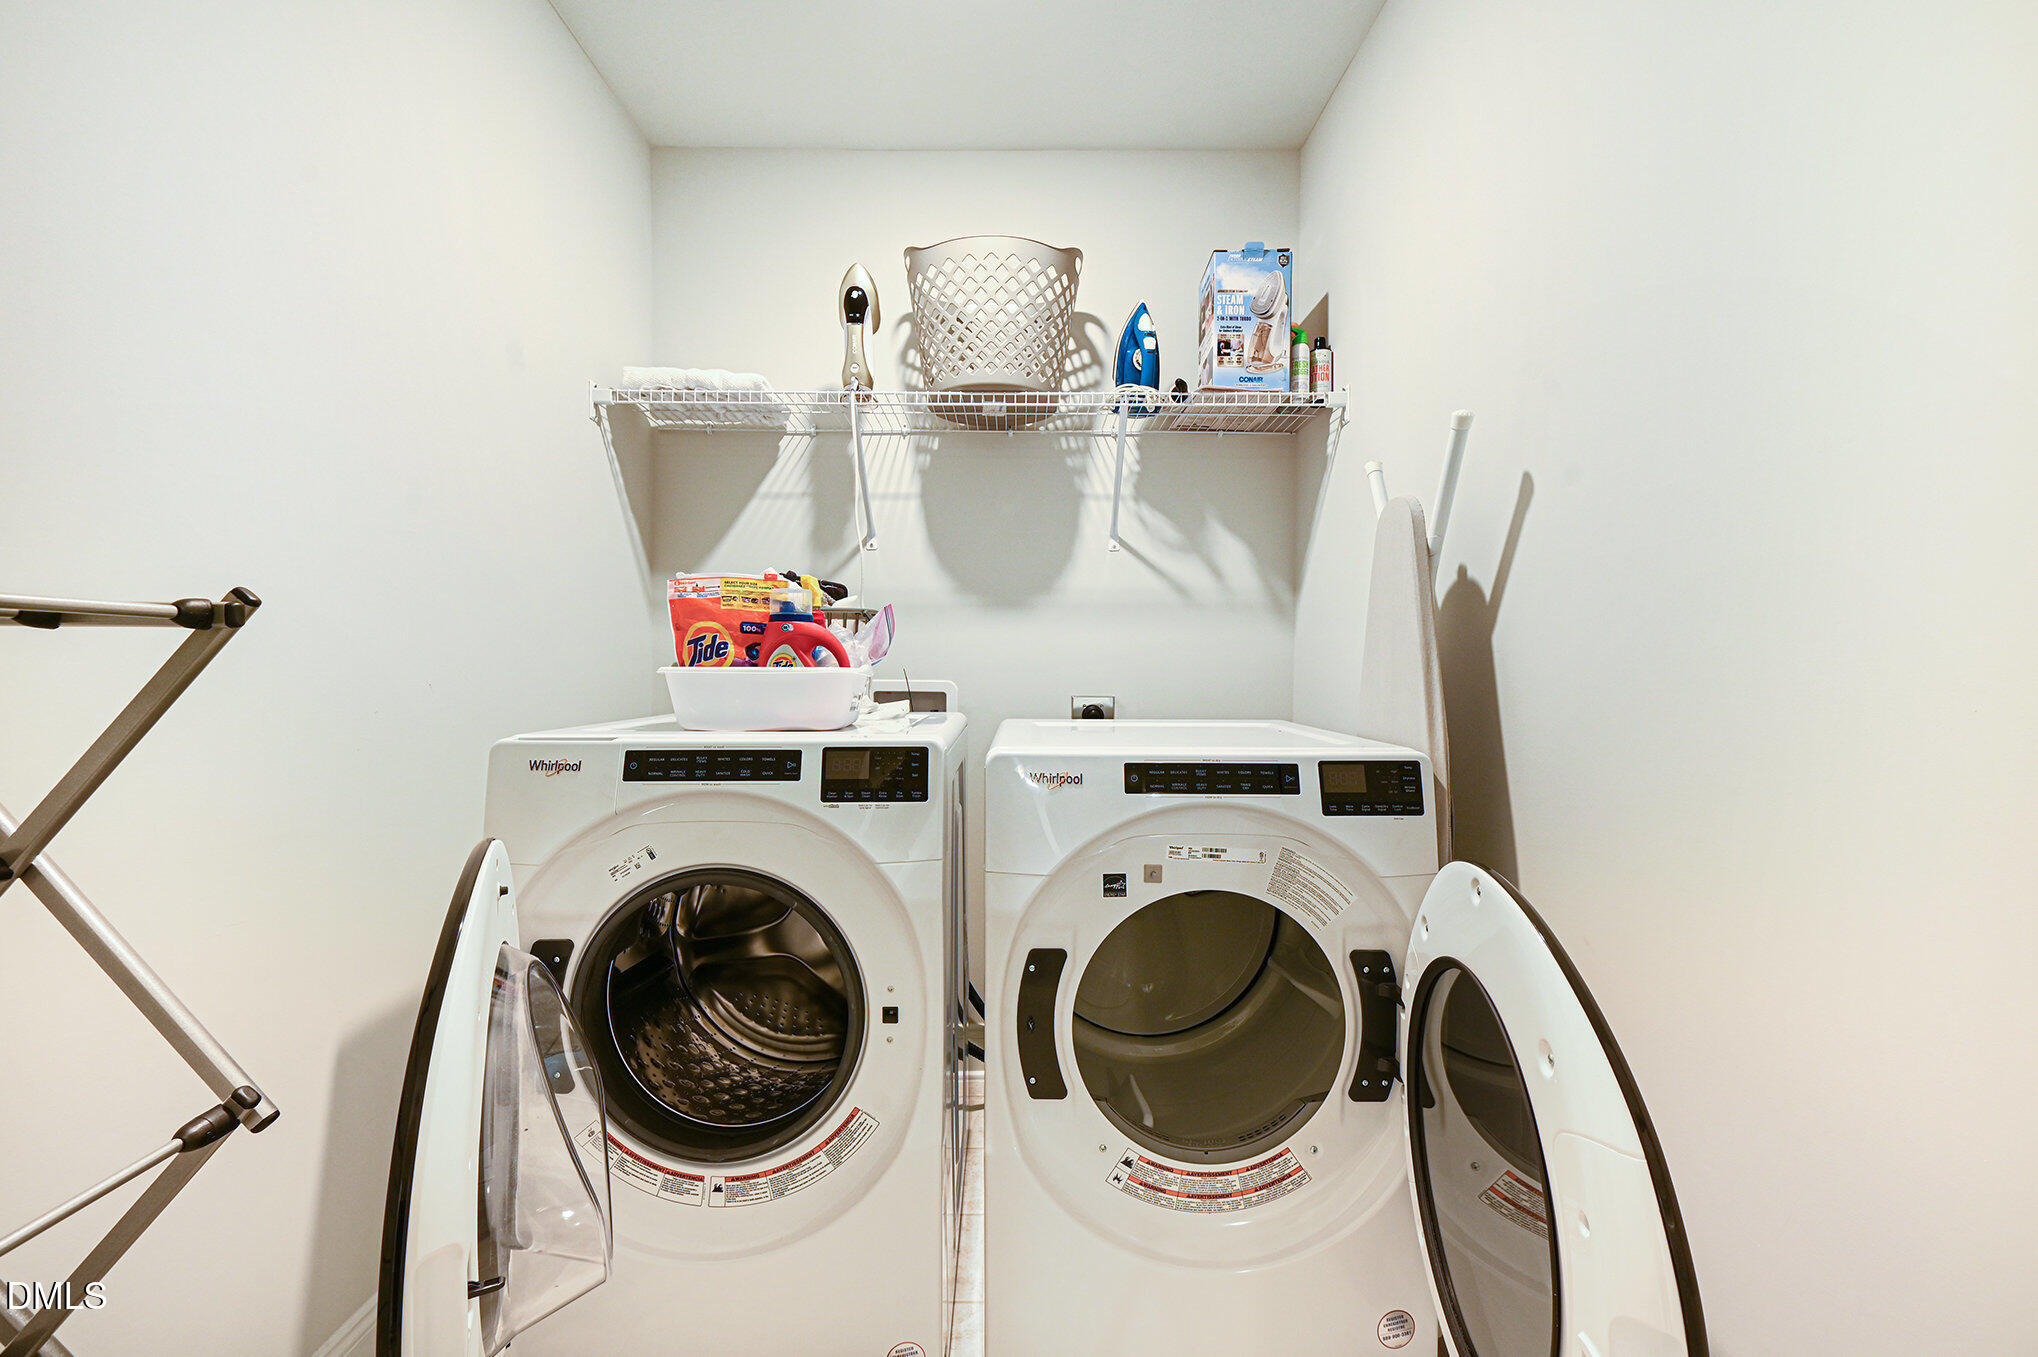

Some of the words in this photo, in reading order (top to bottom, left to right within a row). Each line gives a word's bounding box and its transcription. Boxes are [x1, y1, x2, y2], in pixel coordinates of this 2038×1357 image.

[1216, 295, 1244, 305] STEAM
[1216, 305, 1223, 315] &
[1225, 305, 1245, 315] IRON
[687, 634, 730, 667] Tide
[529, 759, 582, 776] Whirlpool
[1029, 772, 1083, 787] Whirlpool
[736, 1173, 760, 1182] WARNING
